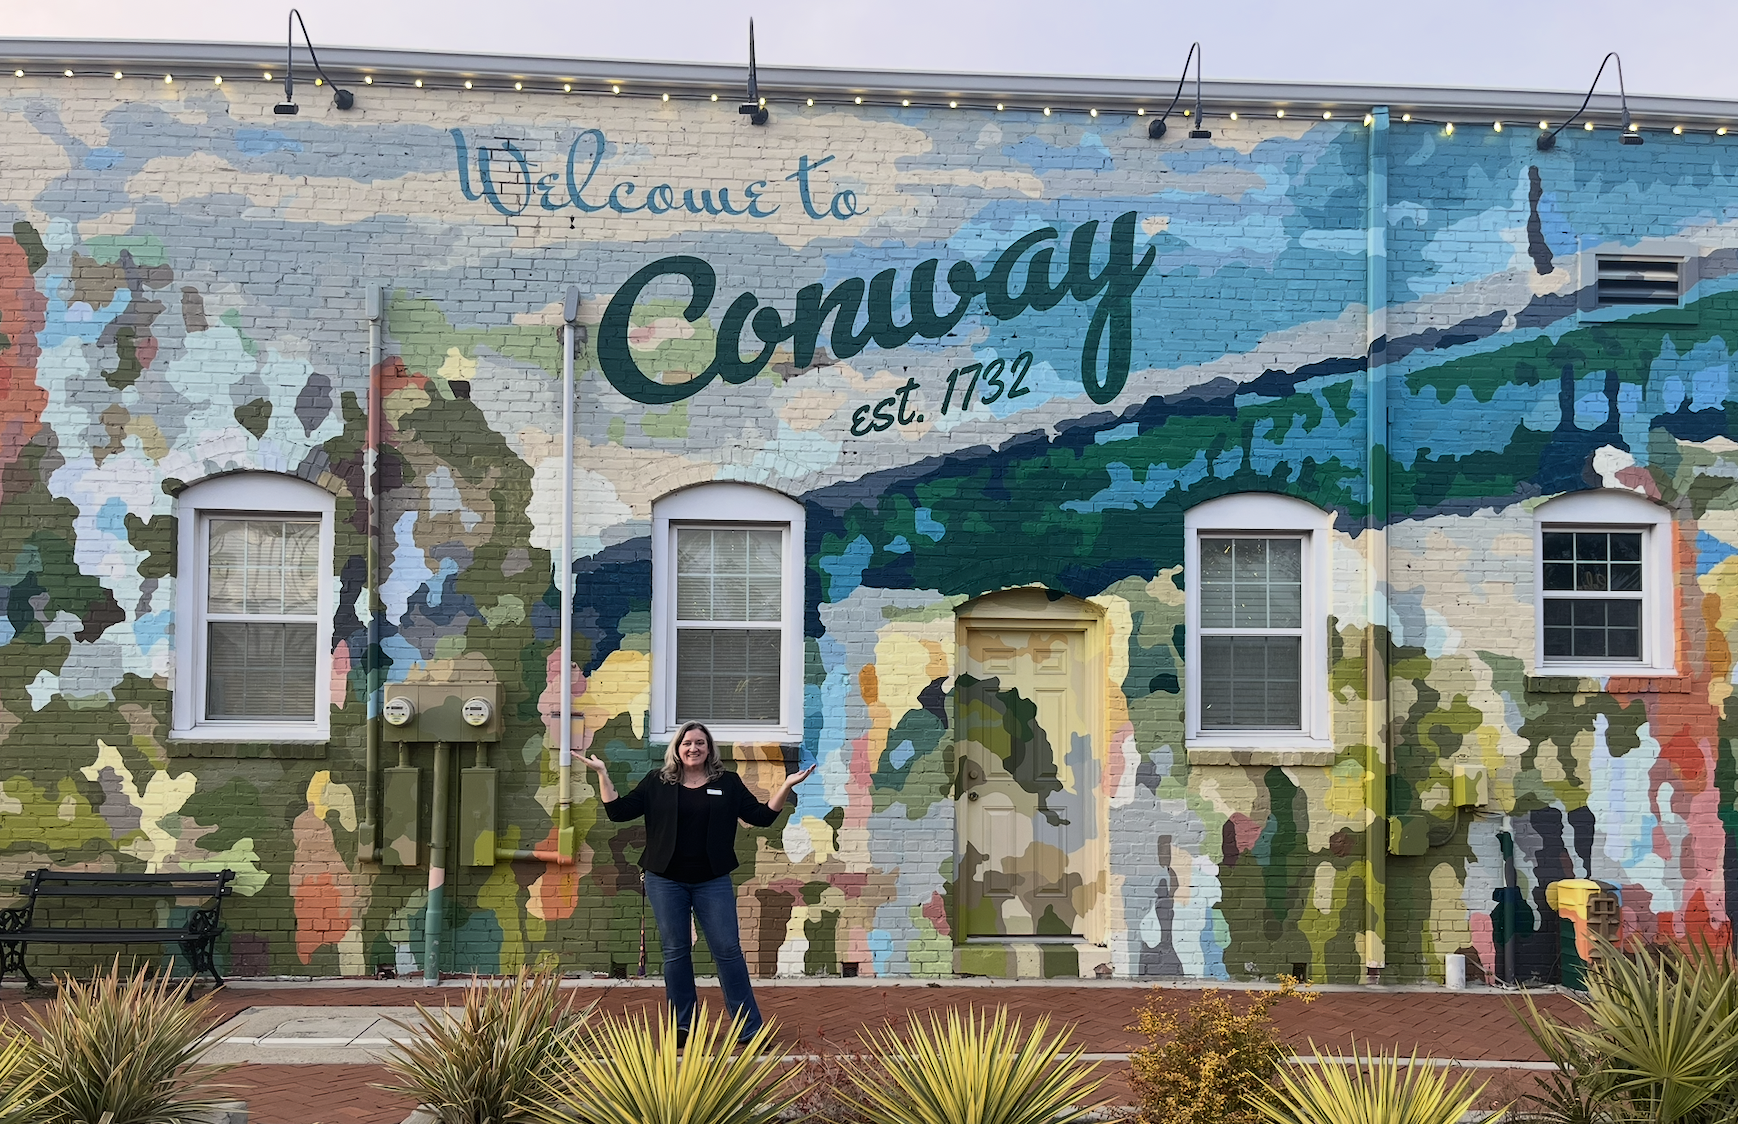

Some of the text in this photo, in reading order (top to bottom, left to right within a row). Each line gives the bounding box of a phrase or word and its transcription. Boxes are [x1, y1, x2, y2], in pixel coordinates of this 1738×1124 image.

[449, 128, 869, 220] Welcome to
[598, 211, 1156, 405] Conway
[940, 351, 1033, 415] 1732
